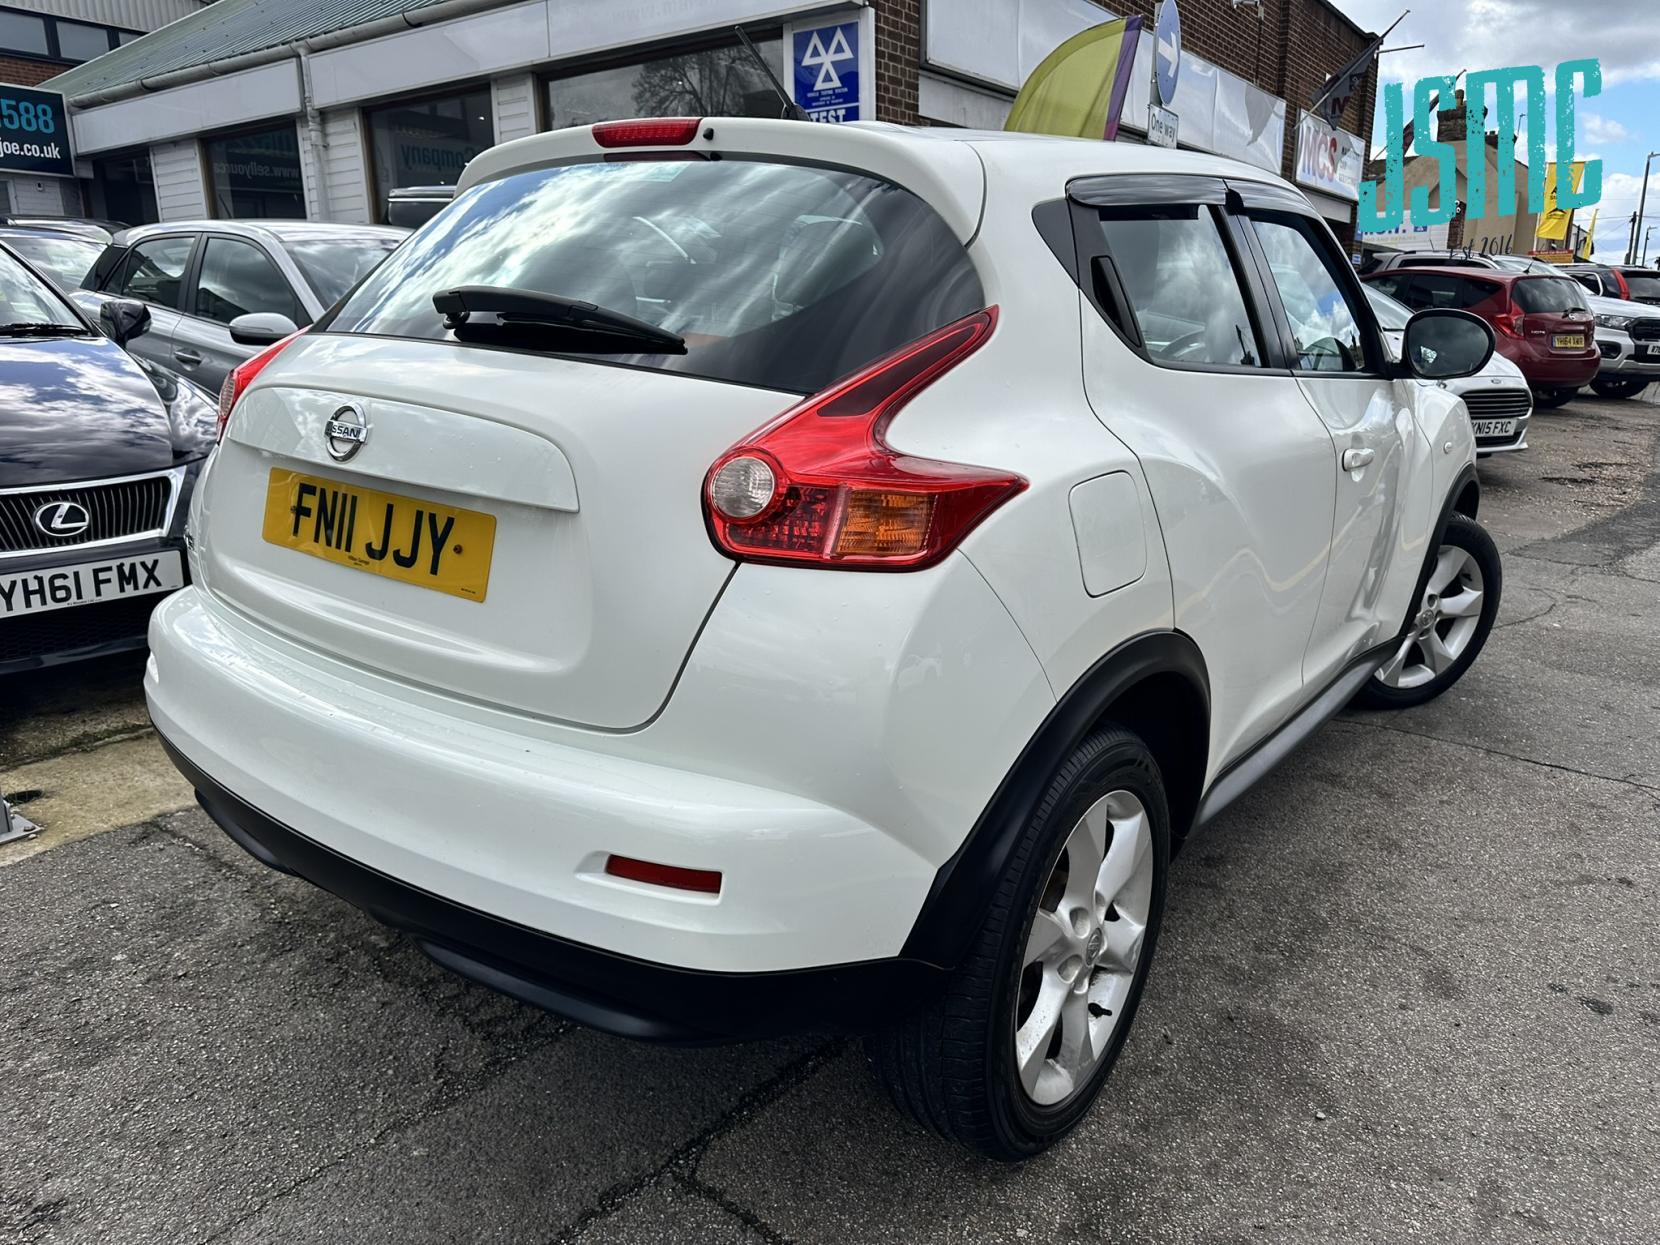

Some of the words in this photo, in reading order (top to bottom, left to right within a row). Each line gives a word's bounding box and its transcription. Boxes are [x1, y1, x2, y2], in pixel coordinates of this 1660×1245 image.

[0, 98, 55, 134] 588
[810, 109, 846, 124] TEST
[1151, 113, 1163, 134] One
[1164, 123, 1176, 142] way
[1300, 121, 1338, 183] MCS
[1492, 420, 1511, 434] FXC
[292, 482, 358, 552] FN11
[365, 503, 455, 576] JJY
[0, 571, 83, 612] YH61
[92, 558, 162, 597] FMX
